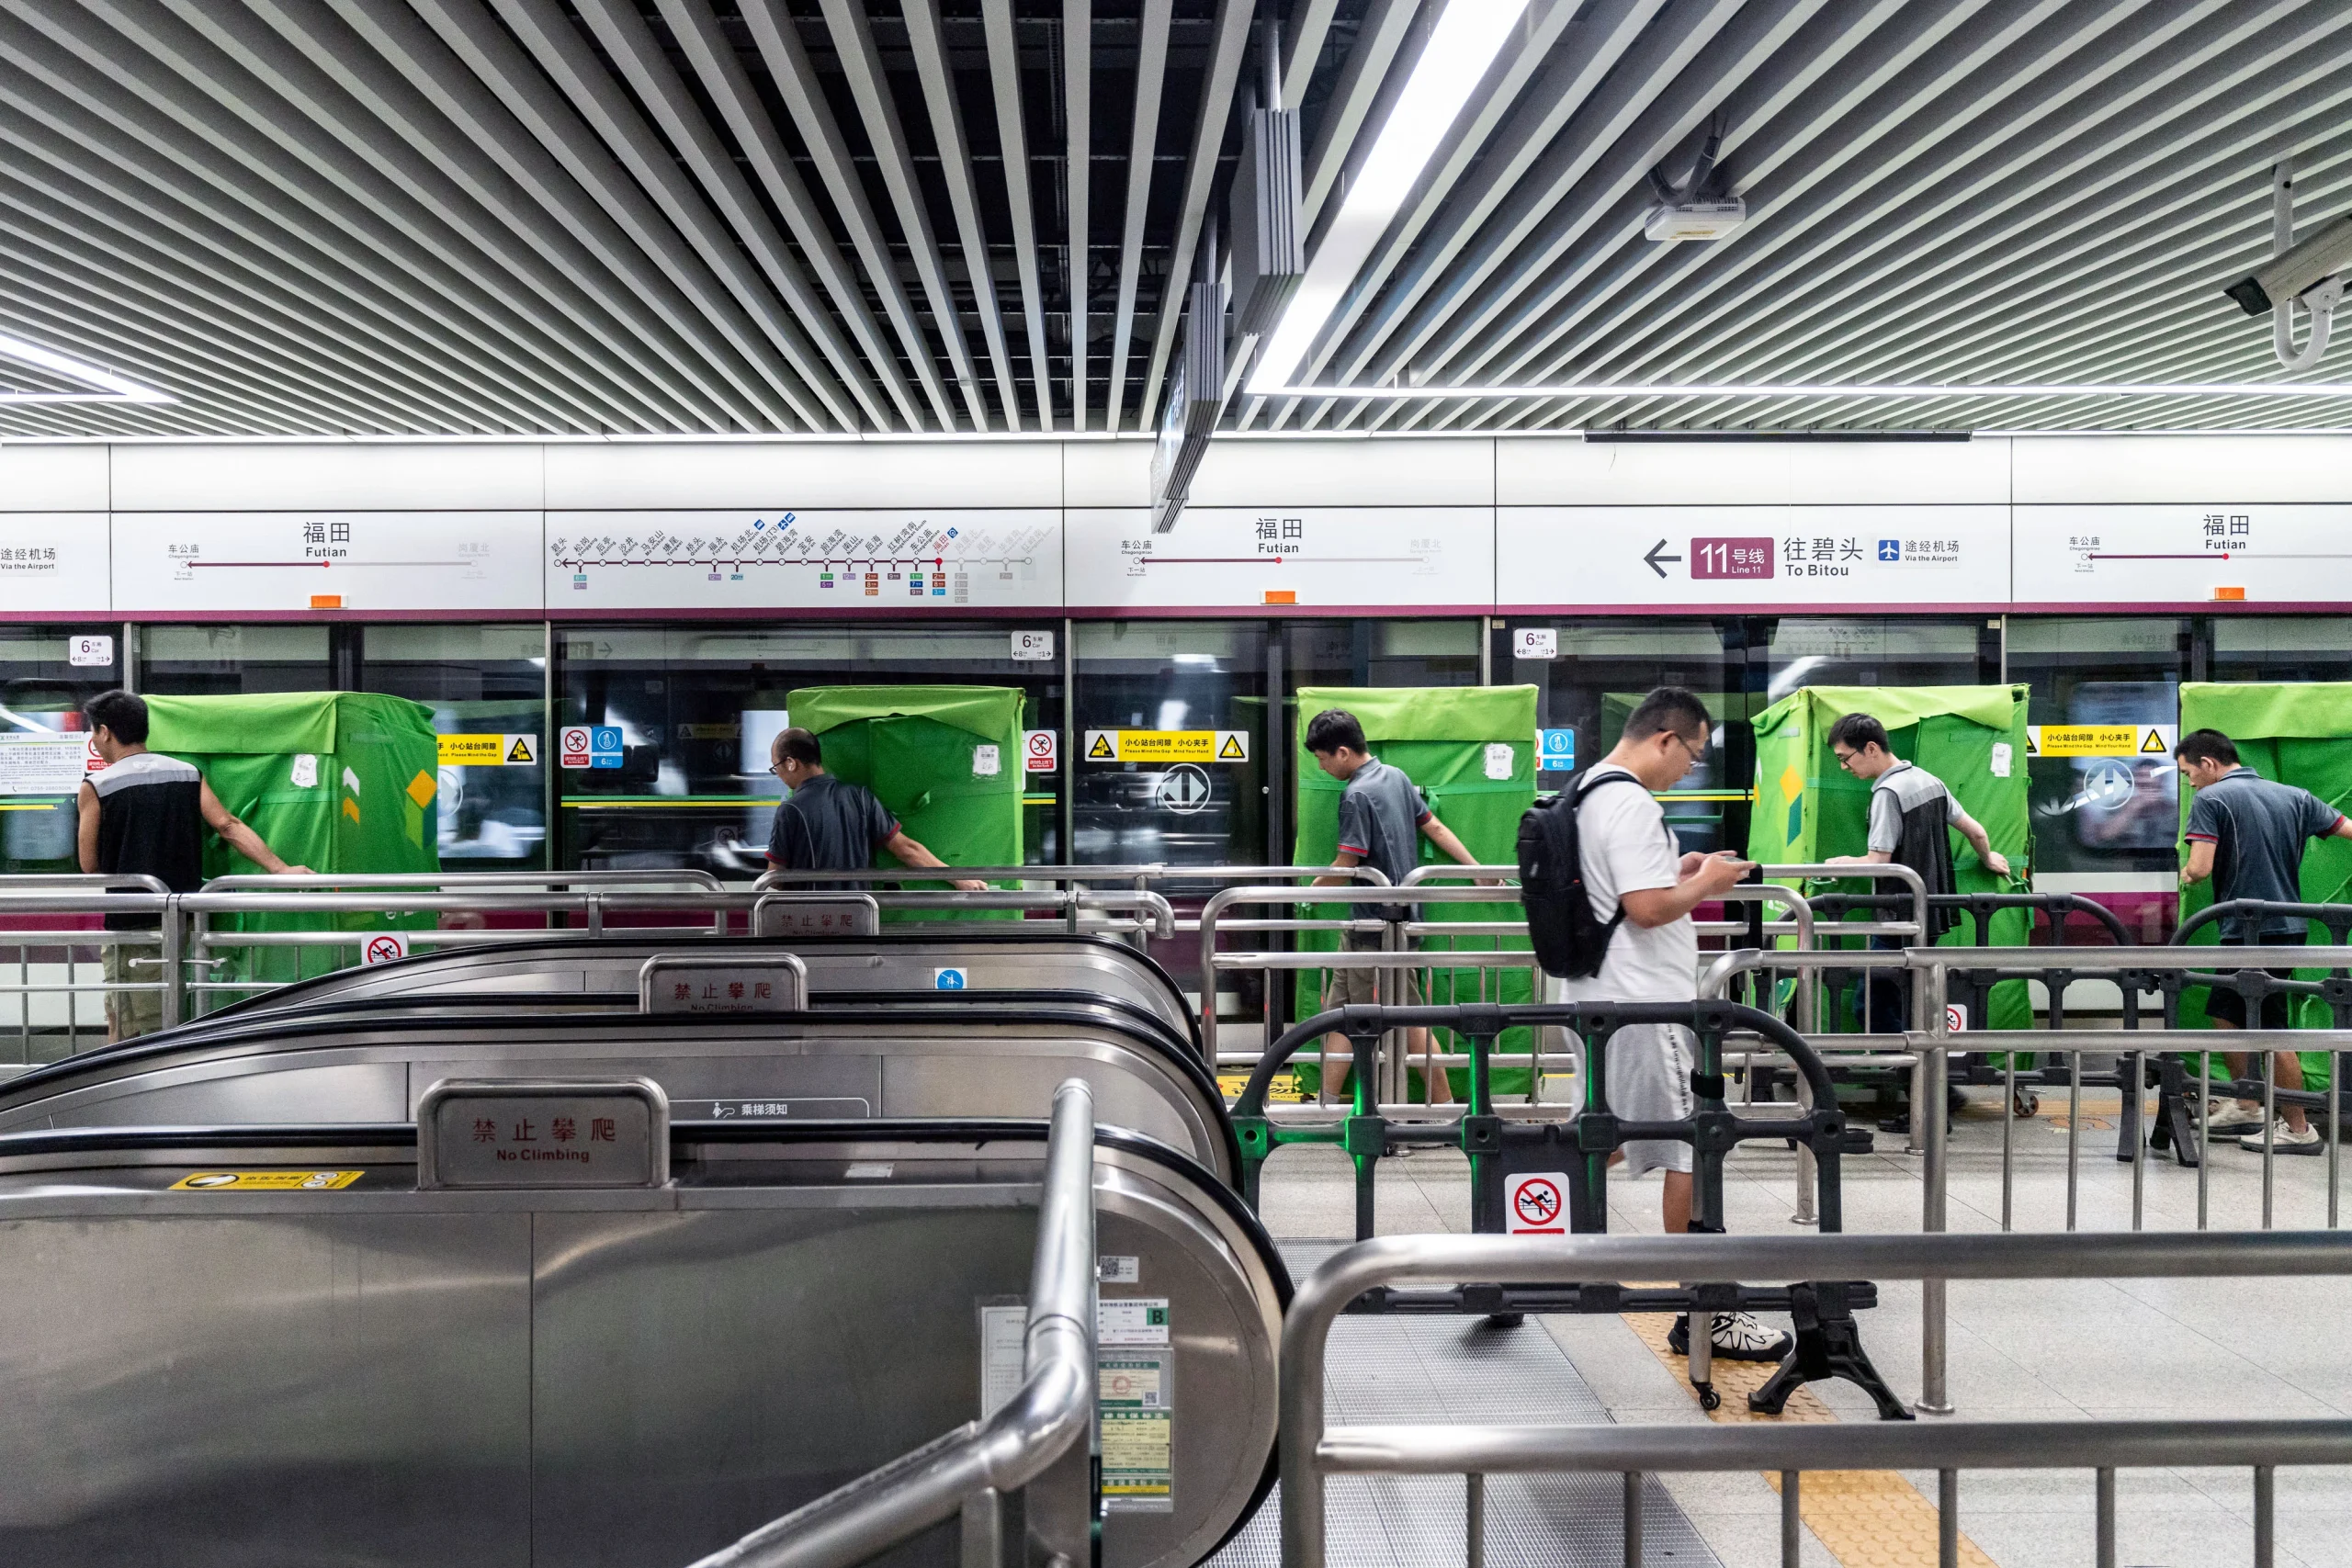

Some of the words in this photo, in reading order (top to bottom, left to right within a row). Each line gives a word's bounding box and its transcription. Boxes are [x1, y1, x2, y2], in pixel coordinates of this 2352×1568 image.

[1255, 518, 1302, 539] 福田
[2203, 514, 2249, 536] 福田
[303, 522, 350, 543] 福田
[1121, 540, 1152, 549] 车公庙
[1905, 540, 1959, 552] 途经机场
[2069, 536, 2100, 546] 车公庙
[2206, 539, 2245, 549] Futian
[1, 548, 55, 560] 途经机场
[168, 544, 199, 553] 车公庙
[306, 547, 346, 557] Futian
[1259, 543, 1299, 553] Futian
[1783, 537, 1863, 561] 往碧头
[1785, 564, 1803, 576] To
[1808, 564, 1849, 576] Bitou
[1023, 635, 1031, 648] 6
[1526, 632, 1534, 646] 6
[82, 640, 90, 653] 6
[2099, 733, 2131, 741] 小心夹手
[782, 914, 853, 928] 禁止攀爬
[675, 982, 772, 999] 禁止攀爬
[741, 1103, 787, 1116] 乘梯须知
[472, 1117, 616, 1143] 禁止攀爬
[497, 1149, 517, 1161] No
[521, 1148, 590, 1163] Climbing
[1152, 1310, 1163, 1324] B
